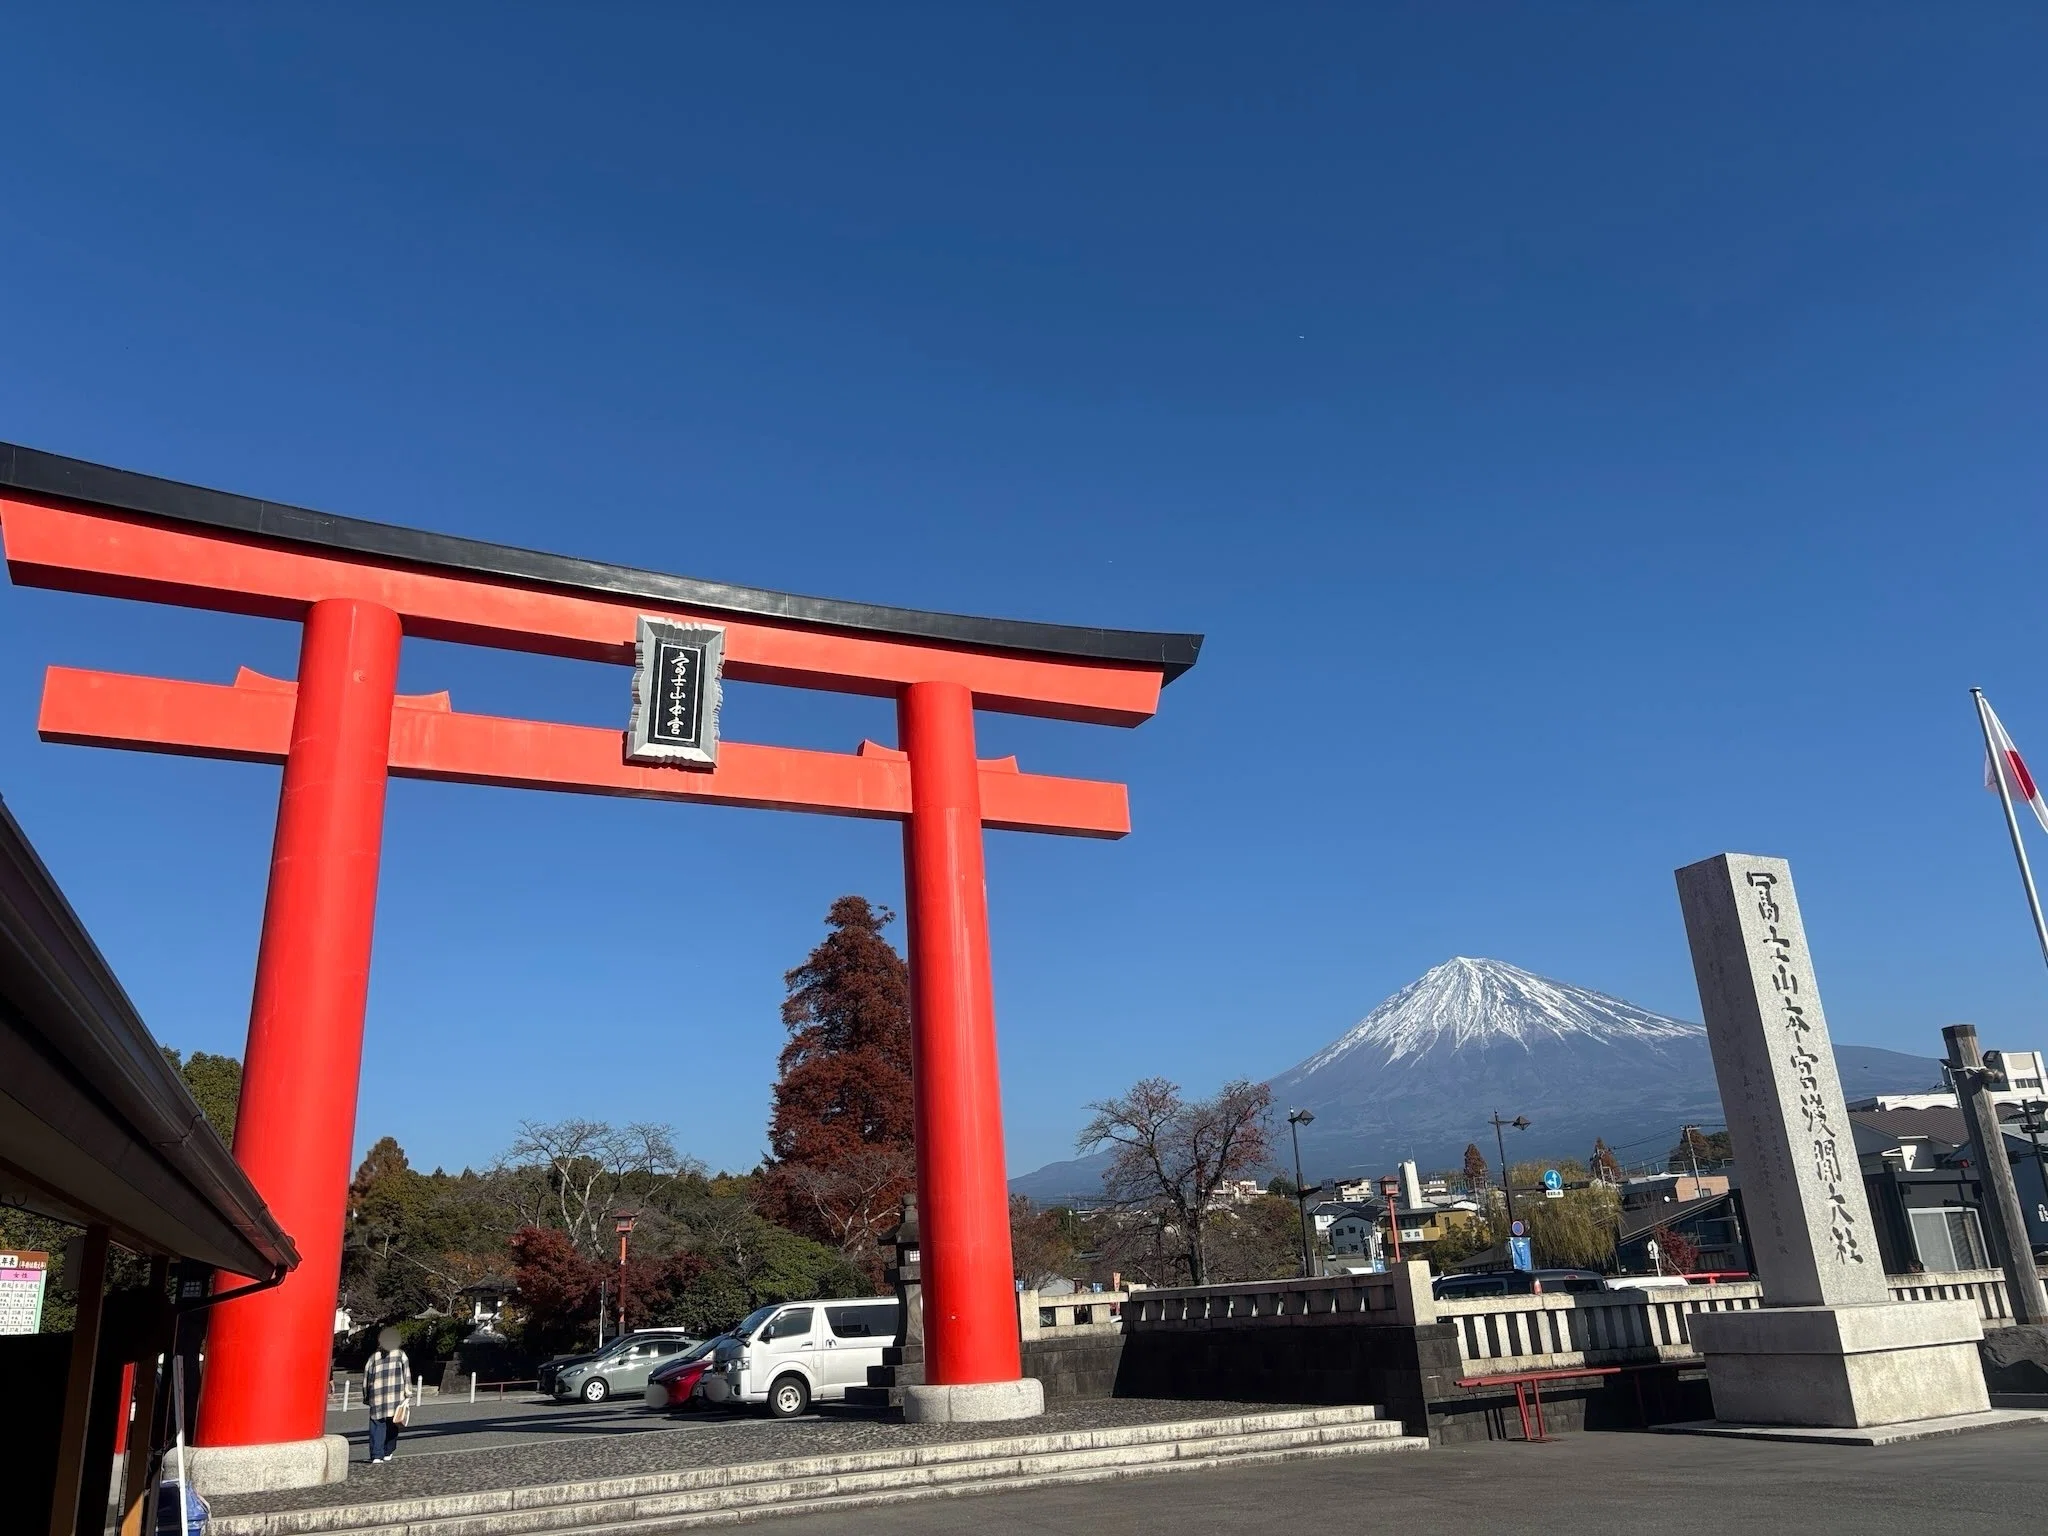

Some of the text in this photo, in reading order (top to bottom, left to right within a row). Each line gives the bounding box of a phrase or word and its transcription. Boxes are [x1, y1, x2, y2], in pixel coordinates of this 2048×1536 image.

[667, 651, 690, 735] 富士山本宮
[0, 1257, 15, 1266] 年表
